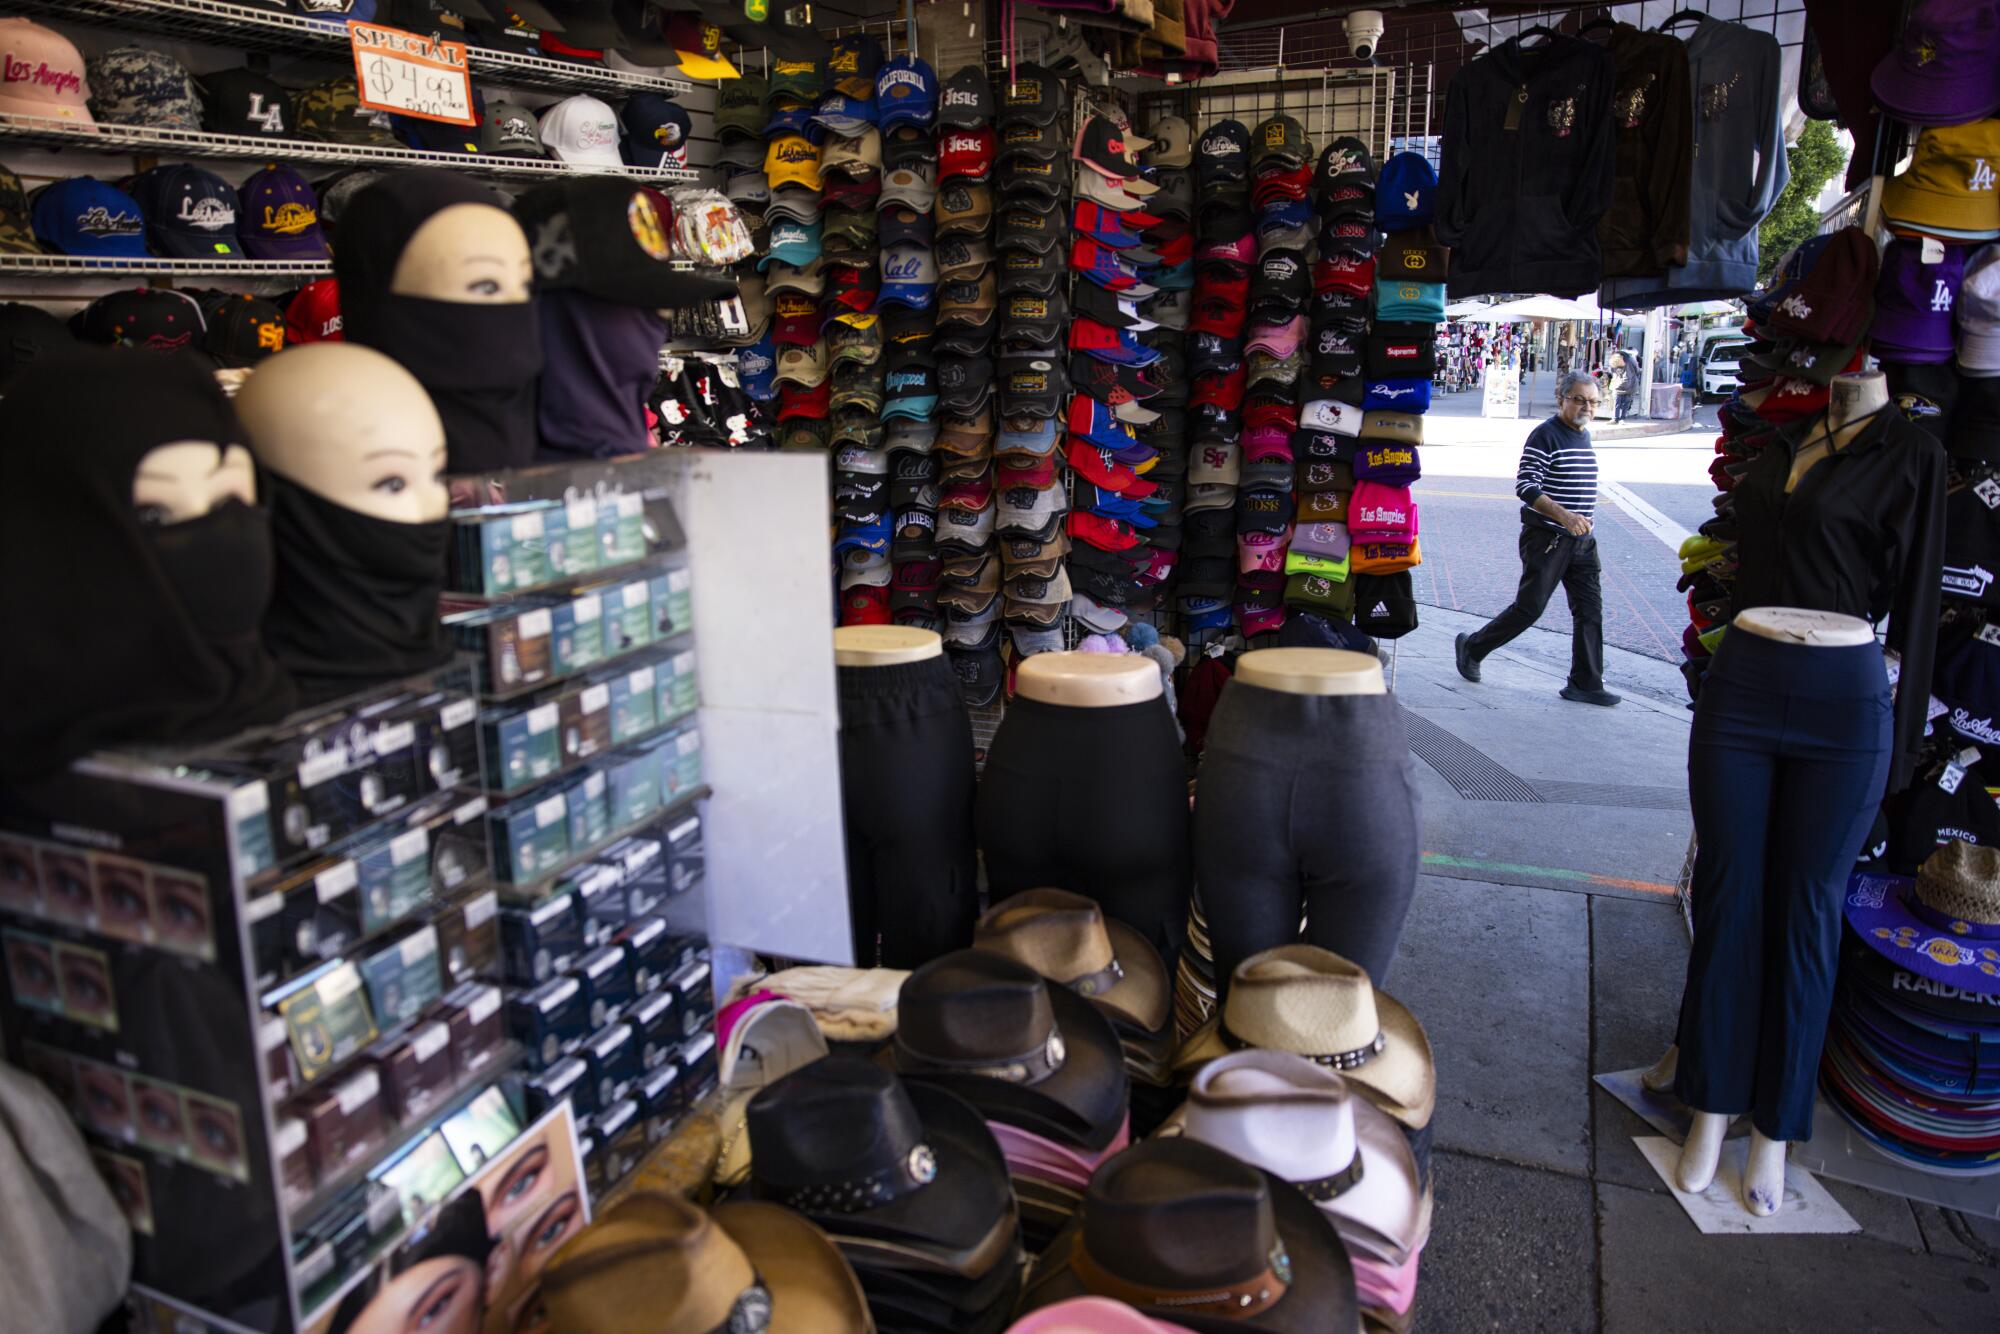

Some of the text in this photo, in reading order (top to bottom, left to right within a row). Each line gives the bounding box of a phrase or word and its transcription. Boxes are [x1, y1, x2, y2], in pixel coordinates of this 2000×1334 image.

[354, 26, 465, 67] SPECIAL
[4, 54, 31, 82] Los
[878, 69, 927, 97] CALIFORNIA
[945, 87, 979, 107] Jesus
[247, 92, 285, 132] LA
[948, 135, 982, 152] Jesus
[1968, 158, 1997, 192] LA
[884, 253, 922, 279] Cali
[1930, 279, 1953, 312] LA
[322, 314, 344, 337] LOS
[1386, 347, 1418, 357] Supreme
[1370, 384, 1416, 400] Dodgers
[1202, 447, 1228, 469] SF
[1366, 447, 1413, 468] Los Angeles
[908, 511, 935, 533] DIEGO
[1360, 506, 1407, 525] Los Angeles
[1937, 827, 1977, 844] MEXICO
